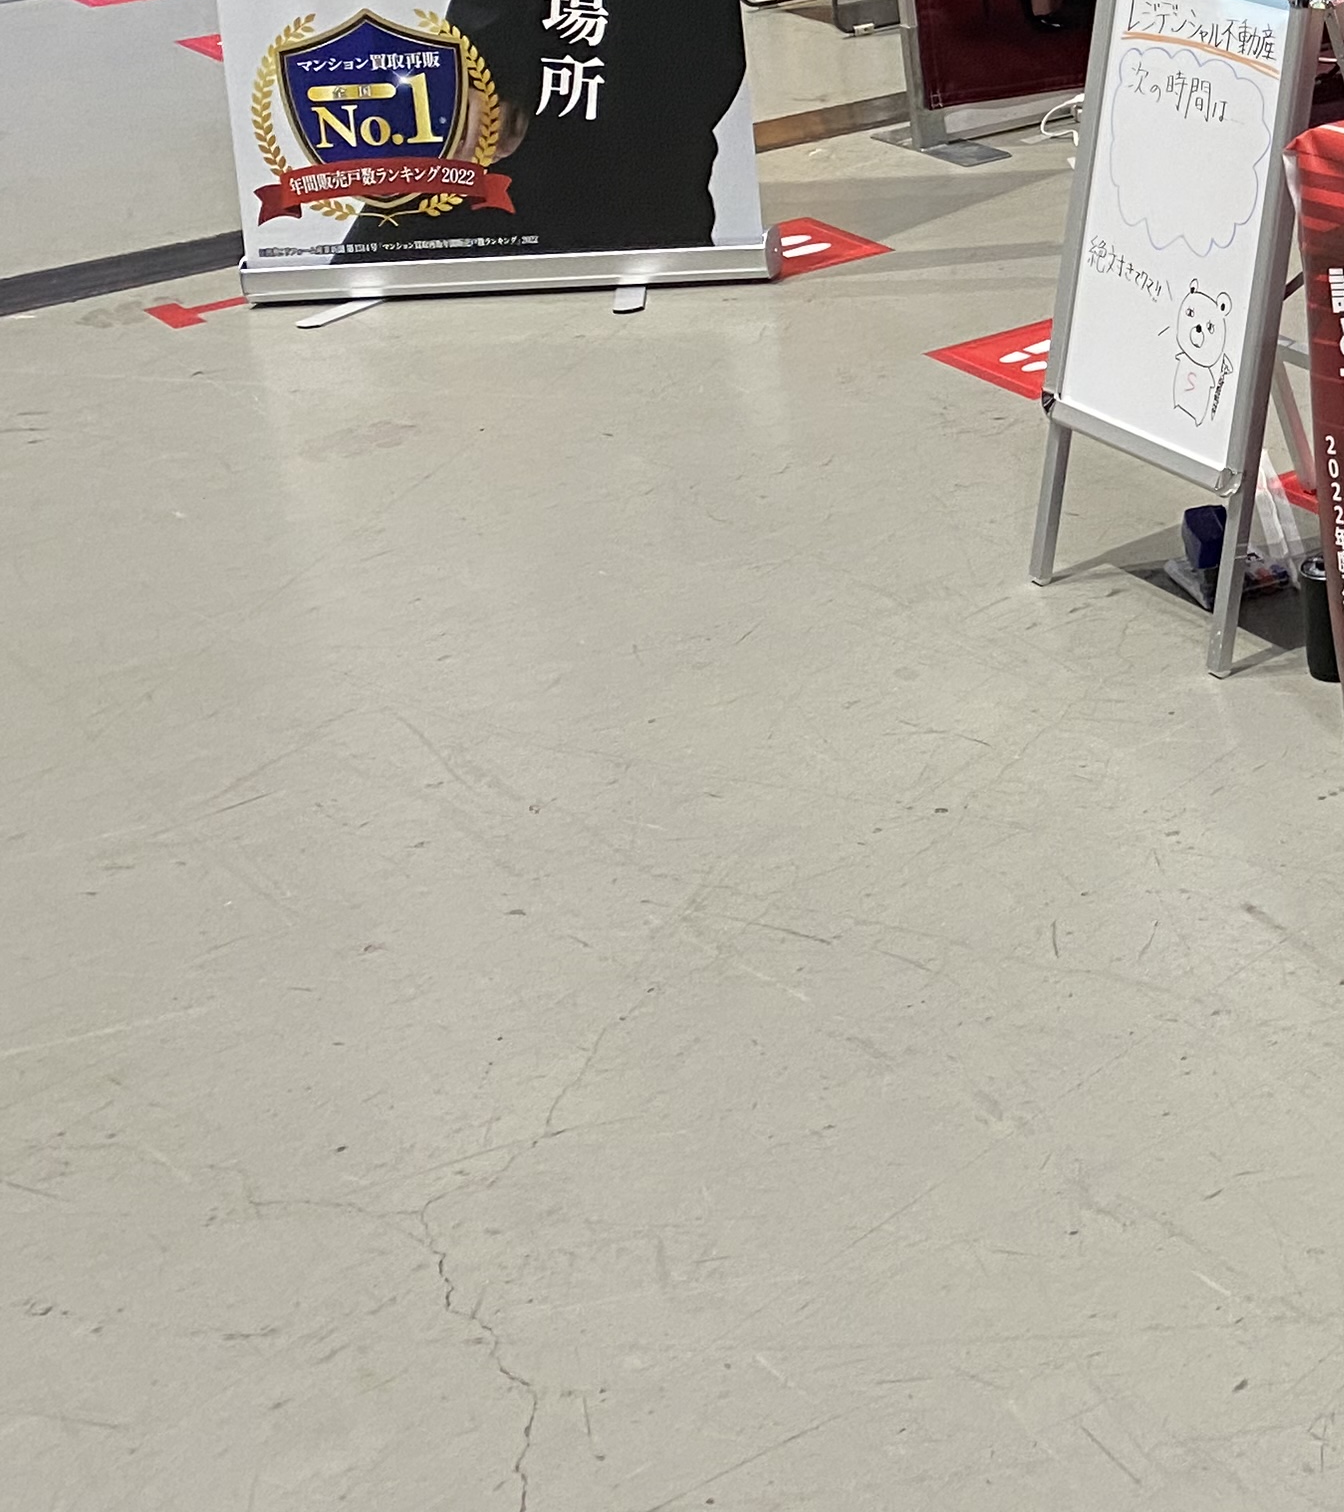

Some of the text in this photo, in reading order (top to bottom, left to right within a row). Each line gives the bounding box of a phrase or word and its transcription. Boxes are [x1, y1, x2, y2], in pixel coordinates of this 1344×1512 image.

[296, 51, 441, 73] マンション買取再販
[310, 72, 444, 149] No.1
[1128, 65, 1230, 124] 次の時間は
